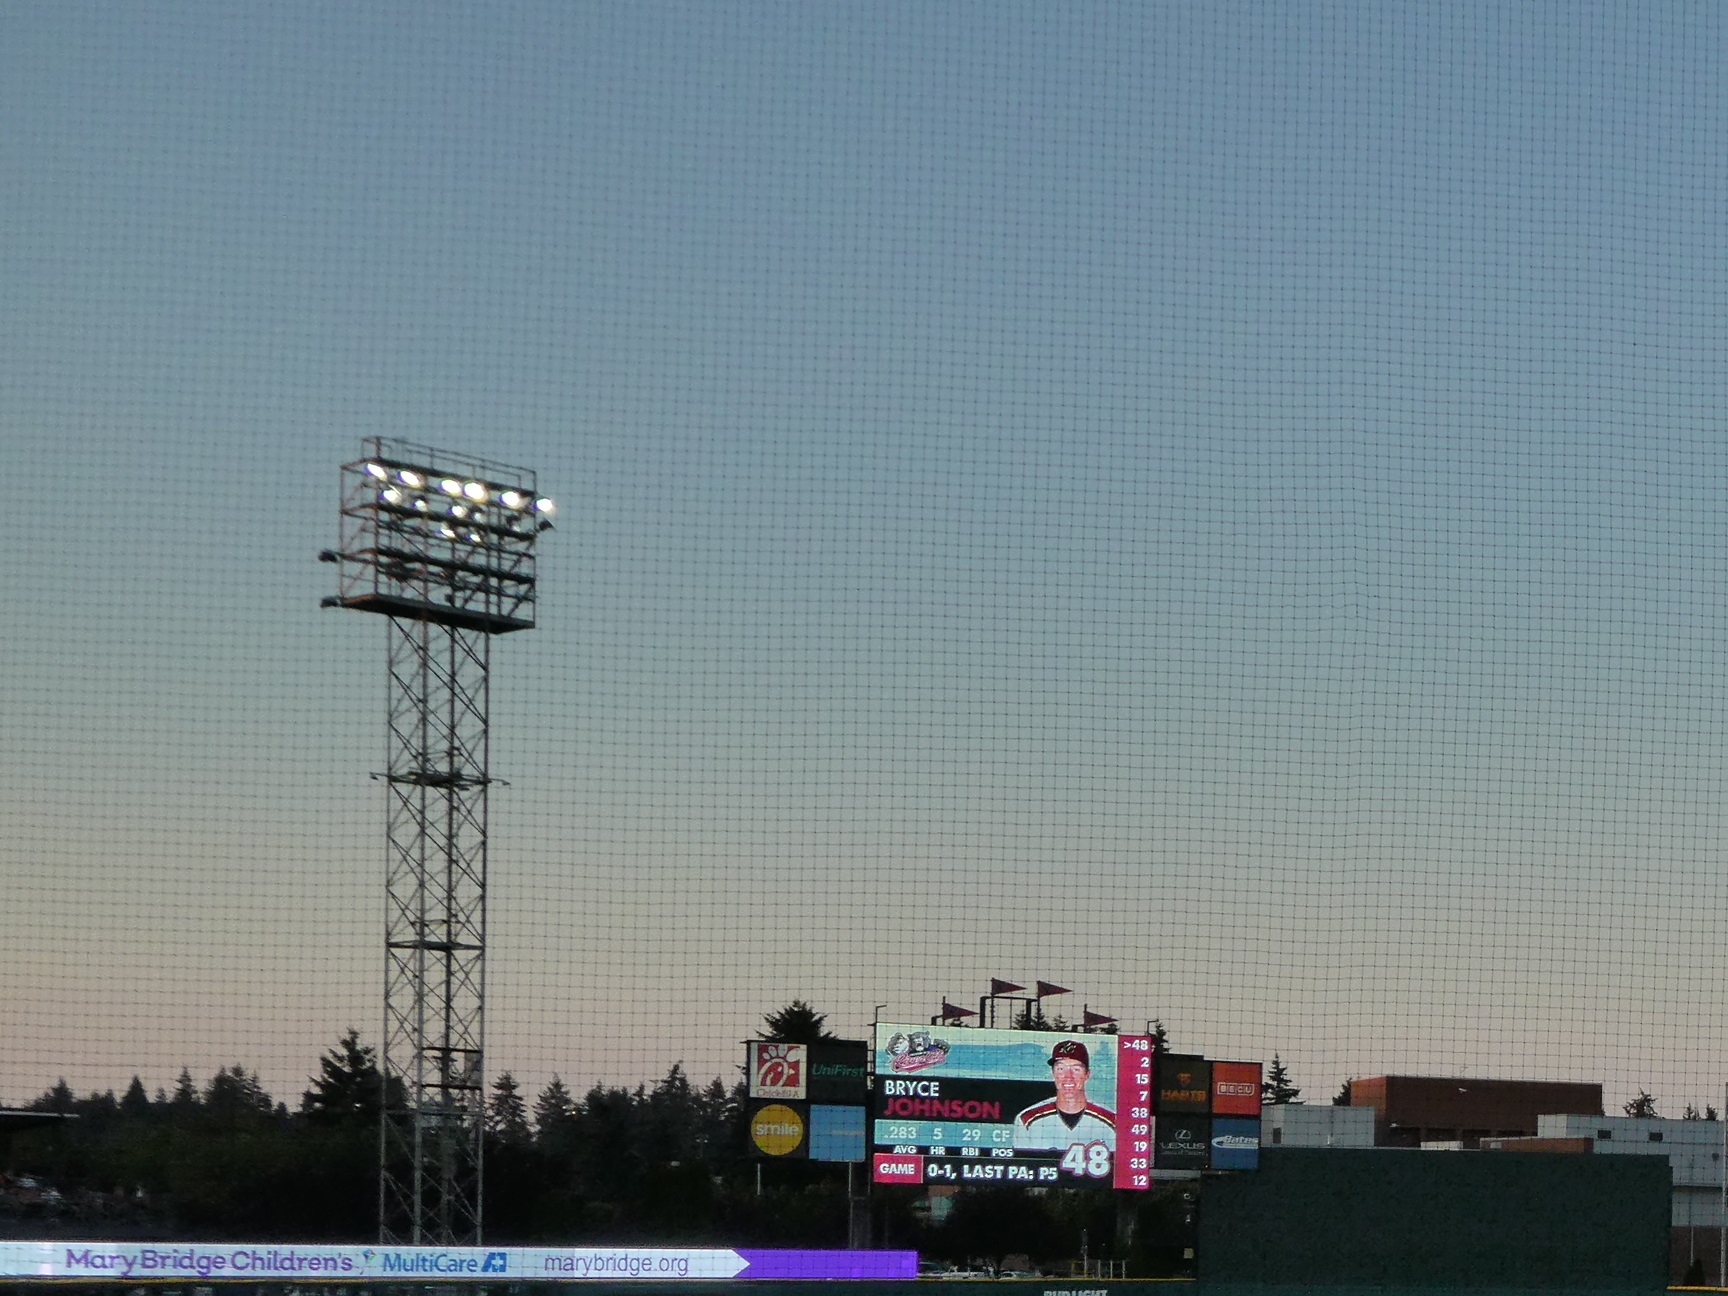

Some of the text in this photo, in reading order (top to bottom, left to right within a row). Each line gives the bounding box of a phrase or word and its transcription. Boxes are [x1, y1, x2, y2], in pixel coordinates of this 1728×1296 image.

[1140, 1058, 1150, 1068] 2
[812, 1063, 865, 1077] UniFirst
[1135, 1074, 1148, 1084] 15
[884, 1080, 940, 1097] BRYCE
[1220, 1085, 1252, 1093] BECU
[1139, 1091, 1149, 1101] 7
[884, 1098, 1001, 1119] JOHNSON
[1131, 1108, 1148, 1118] 38
[756, 1122, 800, 1136] smile
[883, 1126, 1011, 1142] .283 5 29 CF
[1131, 1125, 1148, 1135] 49
[893, 1145, 1014, 1158] AVG HR RBI POS
[1134, 1142, 1148, 1152] 19
[1161, 1142, 1206, 1150] LEXUS
[1062, 1142, 1112, 1179] 48
[1130, 1159, 1147, 1169] 33
[879, 1163, 915, 1176] GAME
[926, 1164, 1059, 1180] 0-1, LAST PA: P5
[1133, 1176, 1147, 1186] 12
[66, 1249, 354, 1278] Mary Bridge Children's
[382, 1252, 478, 1273] MultiCare
[544, 1254, 689, 1277] marybridge.org
